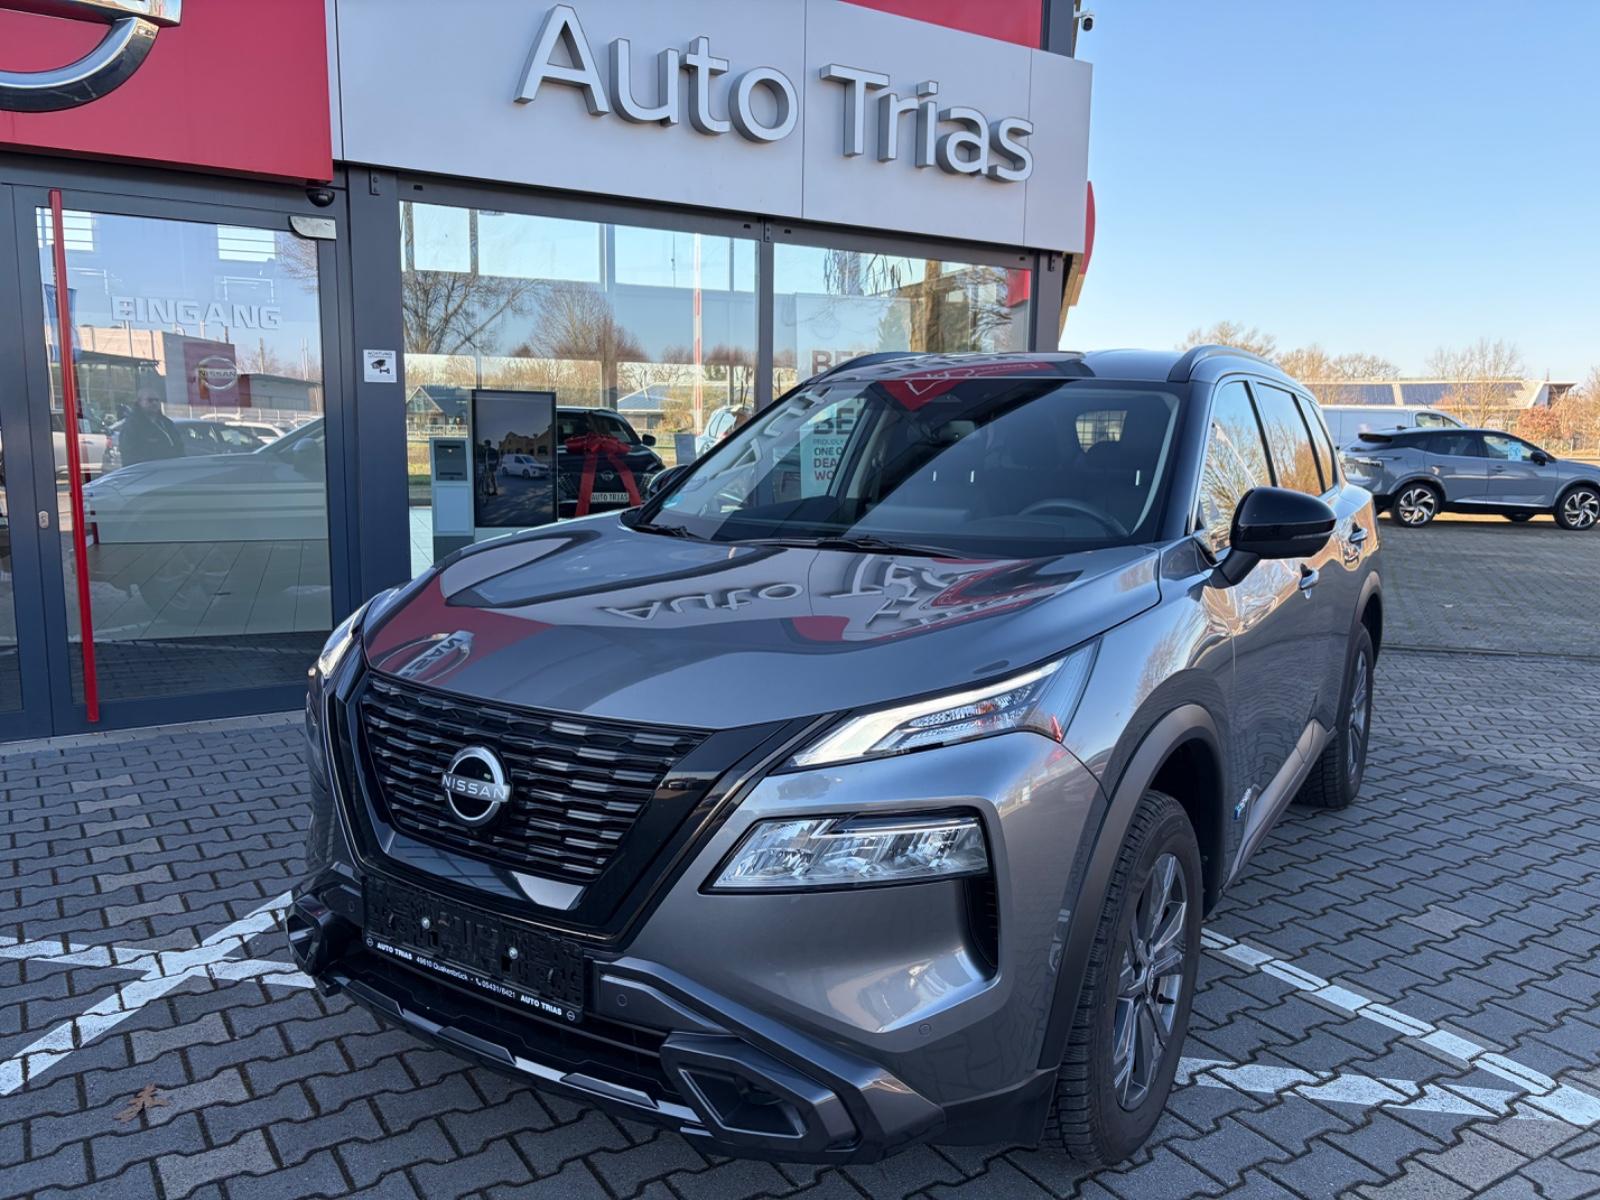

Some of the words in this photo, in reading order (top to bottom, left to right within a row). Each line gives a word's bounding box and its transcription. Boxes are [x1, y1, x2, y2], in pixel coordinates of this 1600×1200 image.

[513, 3, 800, 143] Auto
[819, 63, 1035, 183] Trias
[111, 295, 282, 330] EINGANG
[813, 457, 838, 469] DEA
[814, 470, 835, 481] WO
[592, 493, 608, 501] AUTO
[442, 774, 506, 799] NISSAN
[377, 942, 394, 953] AUTO
[394, 948, 413, 961] TRIAS
[520, 995, 540, 1007] AUTO
[541, 1002, 562, 1016] TRIAS
